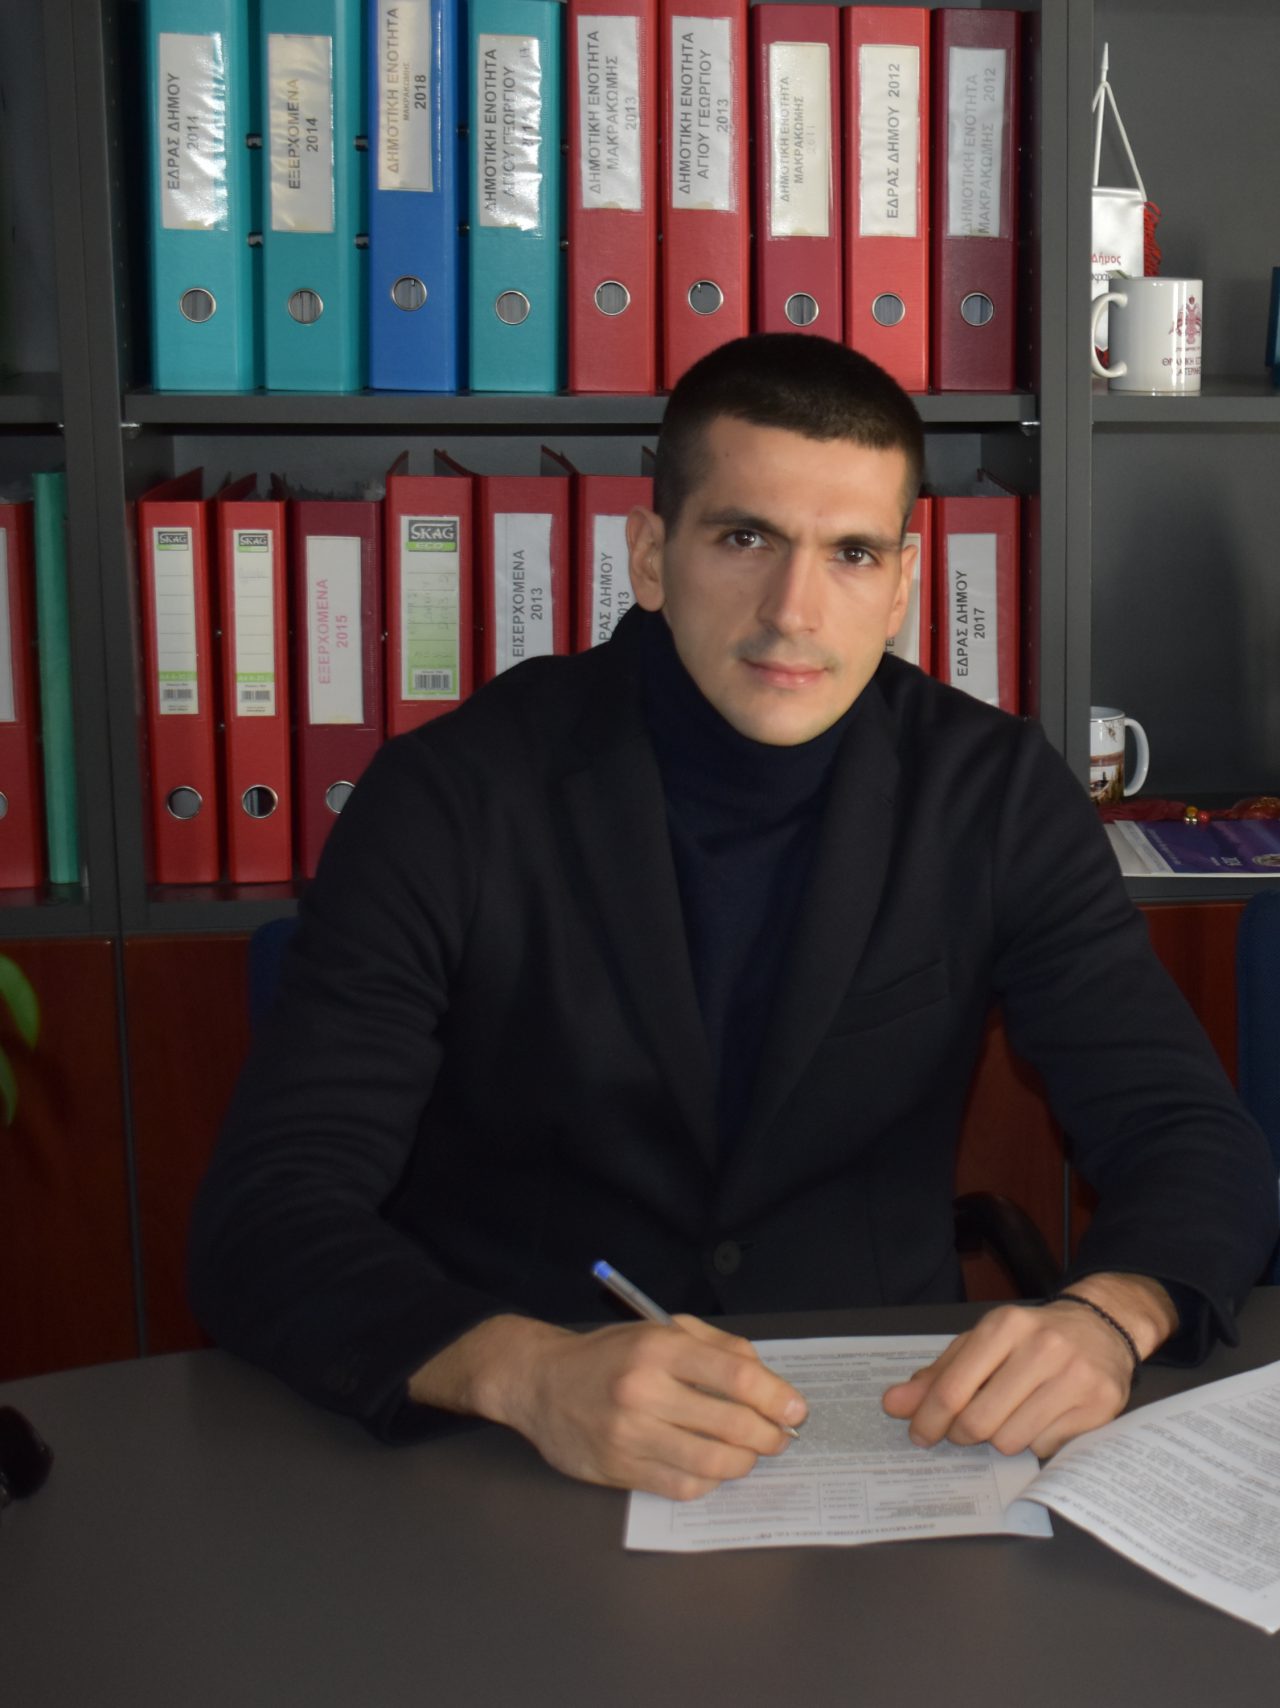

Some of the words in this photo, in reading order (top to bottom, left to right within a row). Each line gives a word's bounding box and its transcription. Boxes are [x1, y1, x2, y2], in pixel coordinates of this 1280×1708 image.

[387, 7, 400, 82] ΕΝΟΤΗΤΑ
[587, 30, 600, 105] ΕΝΟΤΗΤΑ
[681, 31, 694, 106] ΕΝΟΤΗΤΑ
[168, 72, 180, 133] ΔΗΜΟΥ
[402, 62, 411, 121] ΜΑΚΡΑΚΩΜΗΣ
[414, 74, 427, 110] 2018
[484, 48, 497, 124] ΕΝΟΤΗΤΑ
[698, 49, 711, 128] ΓΕΩΡΓΙΟΥ
[779, 76, 789, 134] ΕΝΟΤΗΤΑ
[888, 63, 900, 98] 2012
[983, 67, 996, 102] 2012
[186, 115, 199, 150] 2014
[288, 78, 301, 190] ΕΞΕΡΧΟΜΕΝΑ
[306, 117, 319, 153] 2014
[387, 86, 400, 175] ΔΗΜΟΤΙΚΗ
[605, 56, 619, 170] ΜΑΚΡΑΚΩΜΗΣ
[625, 96, 638, 131] 2013
[716, 98, 729, 133] 2013
[887, 106, 900, 163] ΔΗΜΟΥ
[963, 74, 977, 147] ΕΝΟΤΗΤΑ
[168, 138, 181, 191] ΕΔΡΑΣ
[588, 107, 601, 194] ΔΗΜΟΤΙΚΗ
[678, 108, 691, 194] ΔΗΜΟΤΙΚΗ
[697, 133, 710, 179] ΑΓΙΟΥ
[794, 96, 804, 184] ΜΑΚΡΑΚΩΜΗΣ
[484, 129, 497, 211] ΔΗΜΟΤΙΚΗ
[780, 137, 790, 202] ΔΗΜΟΤΙΚΗ
[887, 167, 899, 218] ΕΔΡΑΣ
[961, 152, 975, 234] ΔΗΜΟΤΙΚΗ
[978, 122, 993, 234] ΜΑΚΡΑΚΩΜΗΣ
[159, 533, 187, 544] SKAG
[240, 534, 267, 545] SKAG
[411, 523, 455, 540] SKAG
[512, 549, 526, 657] ΕΙΣΕΡΧΟΜΕΝΑ
[531, 586, 543, 620] 2013
[599, 552, 613, 608] ΔΗΜΟΥ
[957, 569, 968, 624] ΔΗΜΟΥ
[316, 579, 331, 684] ΕΞΕΡΧΟΜΕΝΑ
[335, 614, 348, 648] 2015
[599, 612, 612, 641] ΡΑΣ
[974, 607, 986, 639] 2017
[957, 628, 969, 677] ΕΔΡΑΣ
